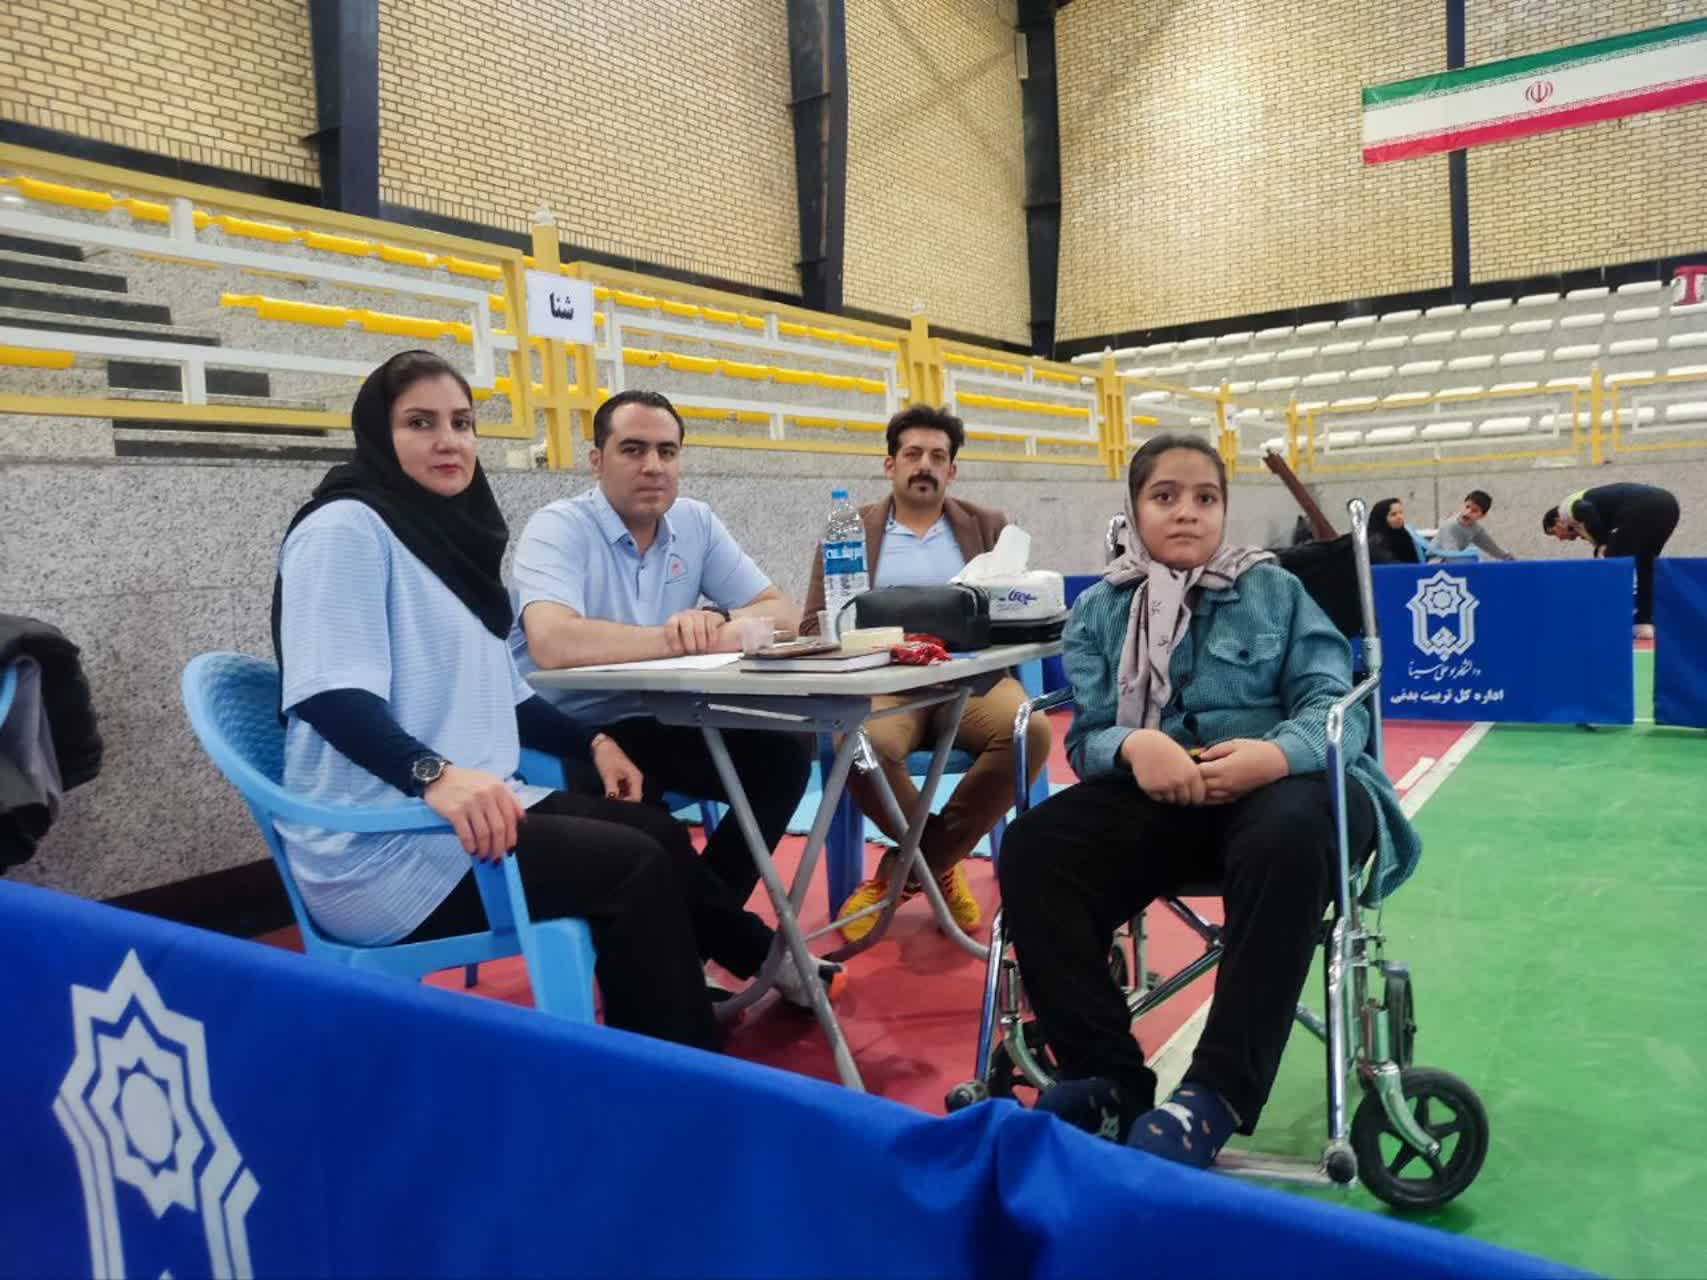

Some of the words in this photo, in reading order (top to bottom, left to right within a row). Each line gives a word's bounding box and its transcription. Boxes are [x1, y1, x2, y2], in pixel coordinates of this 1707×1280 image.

[549, 291, 575, 321] شنا
[1390, 687, 1420, 704] بدنی
[1420, 688, 1453, 704] تربیت
[1454, 687, 1472, 704] کل
[1473, 688, 1504, 704] اداره
